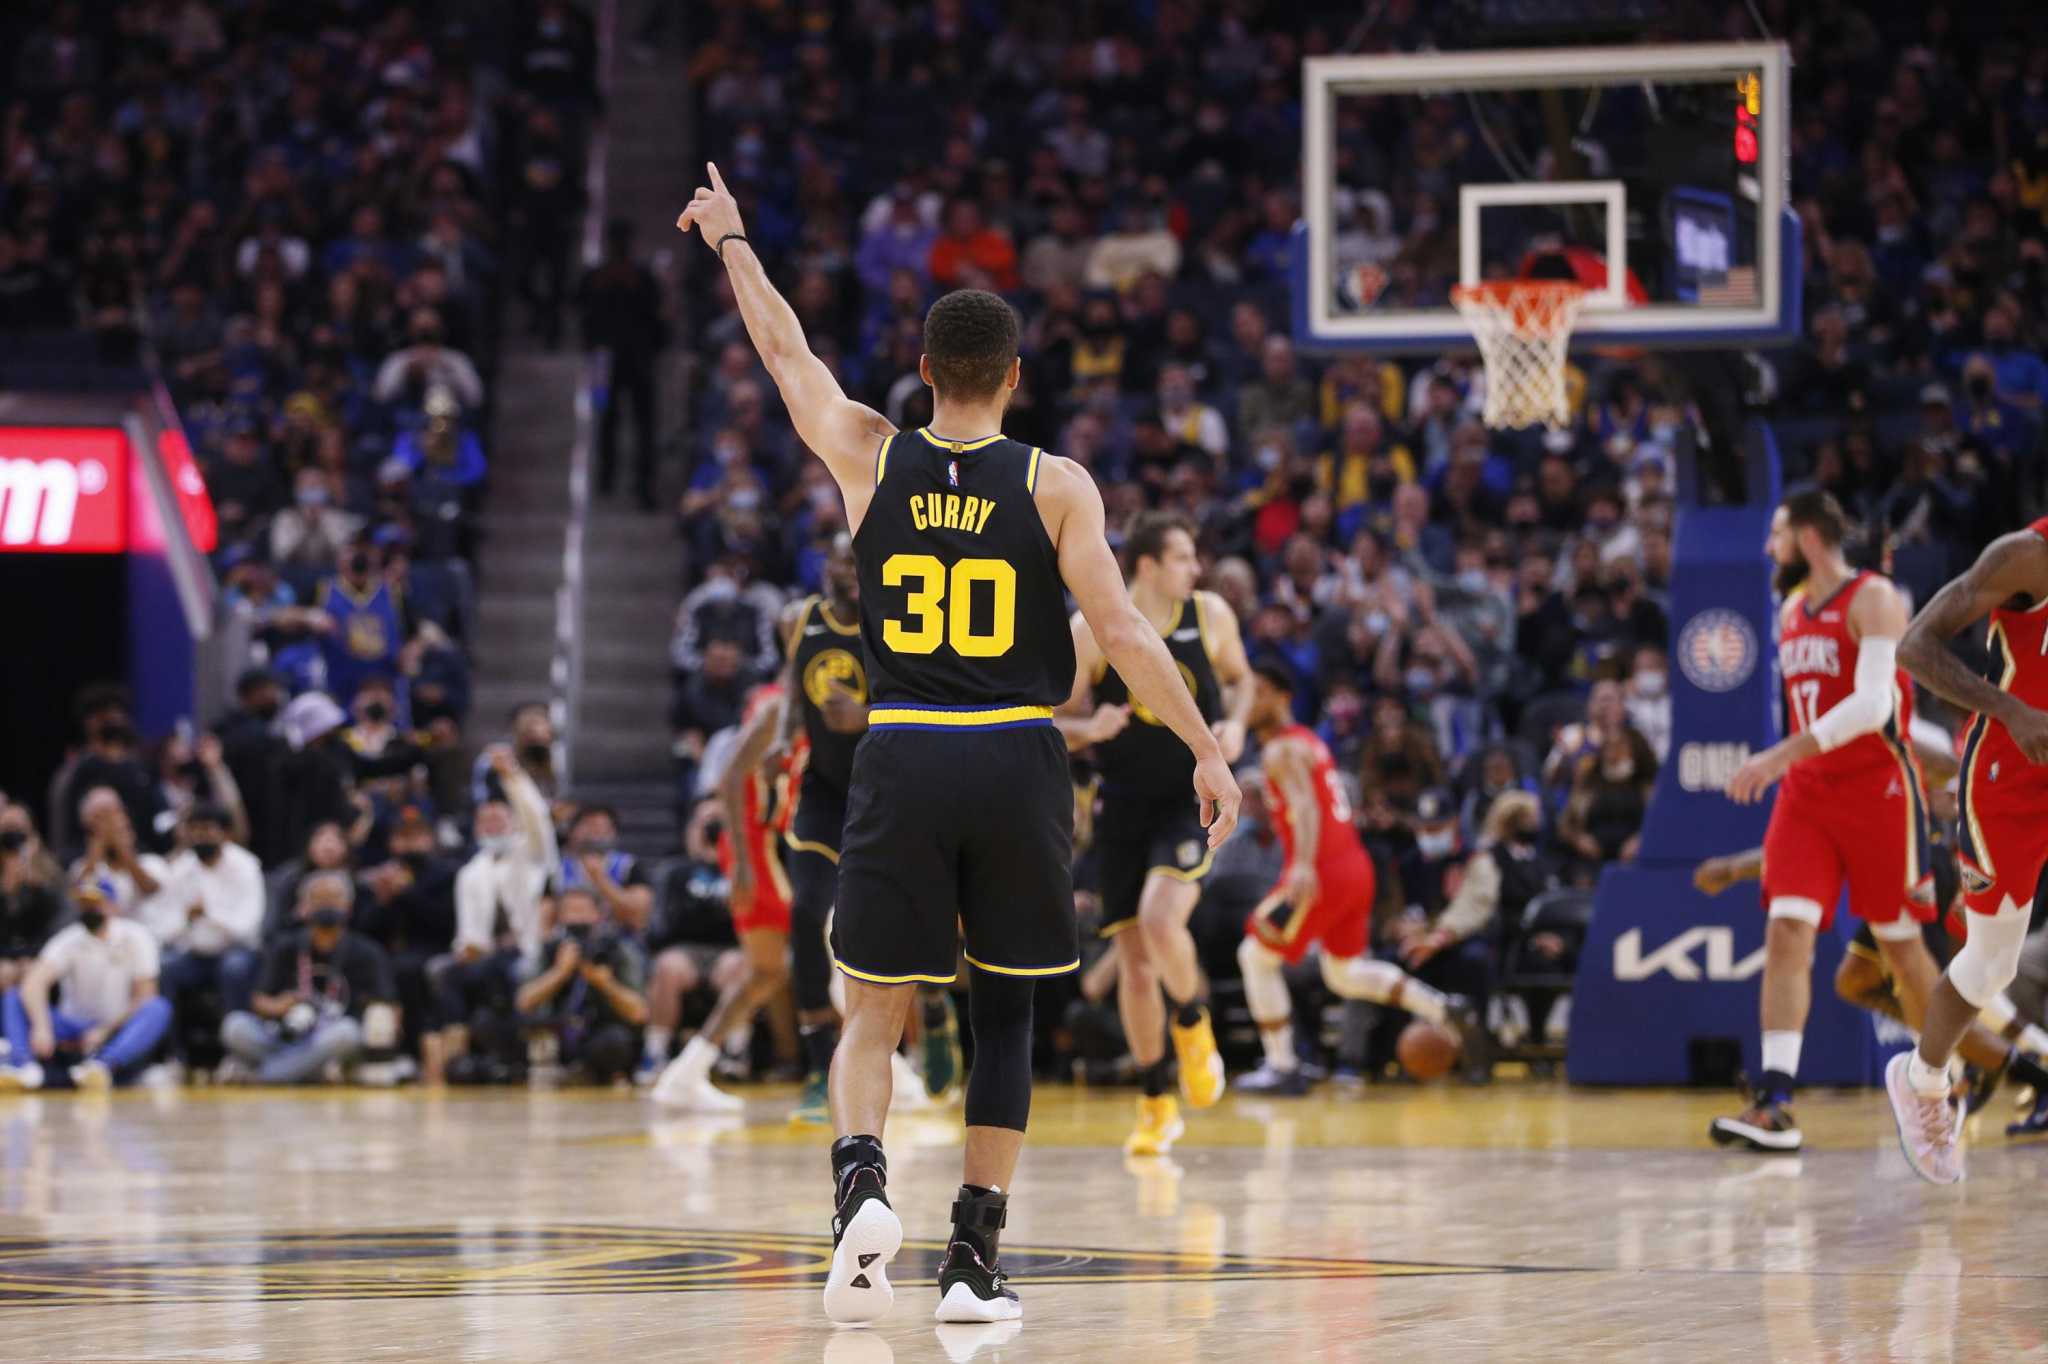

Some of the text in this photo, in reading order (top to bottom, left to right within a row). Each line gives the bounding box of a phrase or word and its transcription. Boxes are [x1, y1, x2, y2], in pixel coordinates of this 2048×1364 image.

[909, 492, 996, 536] CURRY
[882, 553, 1017, 659] 30
[1791, 679, 1821, 736] 17
